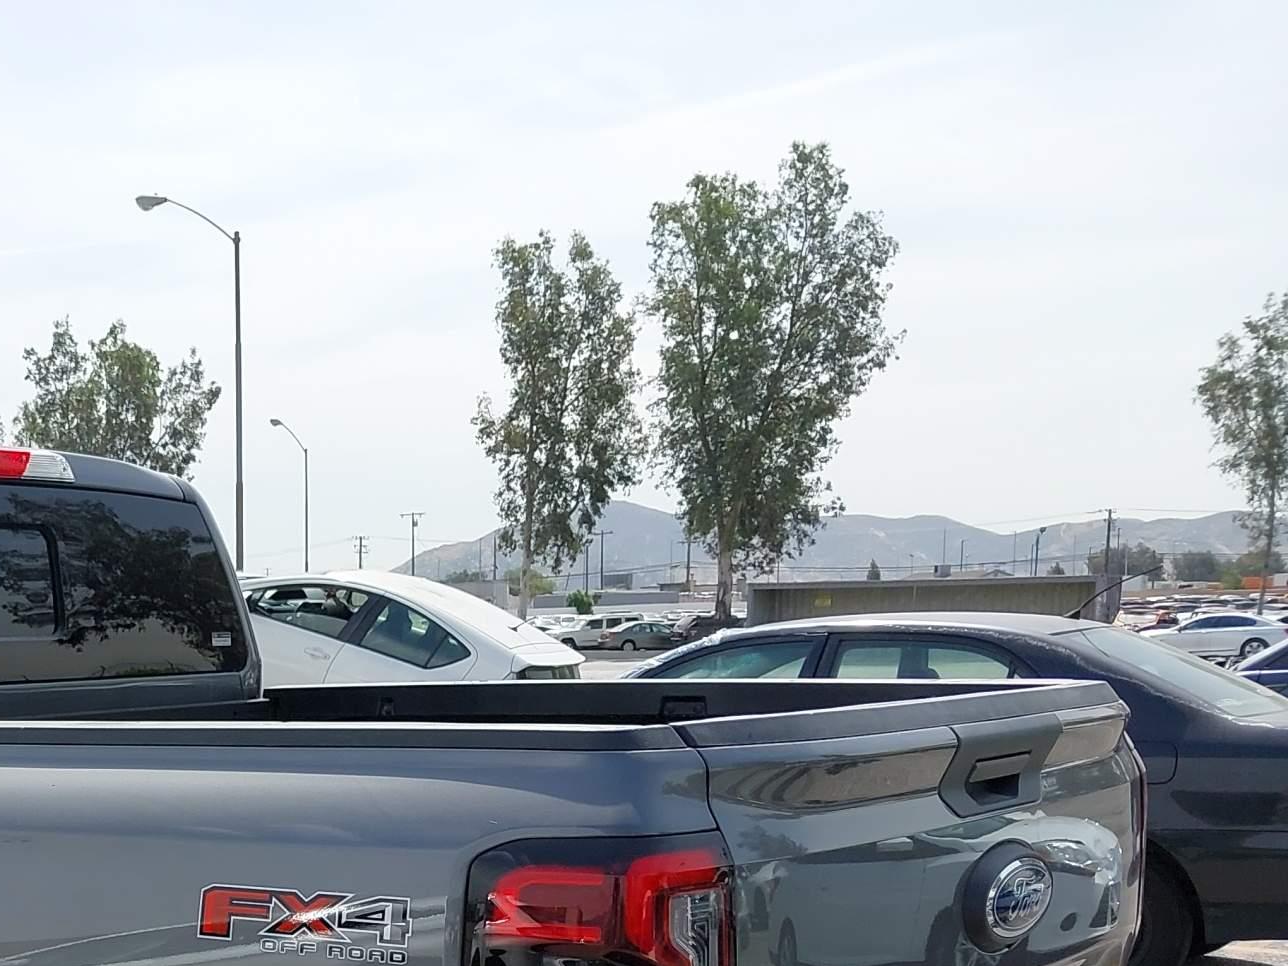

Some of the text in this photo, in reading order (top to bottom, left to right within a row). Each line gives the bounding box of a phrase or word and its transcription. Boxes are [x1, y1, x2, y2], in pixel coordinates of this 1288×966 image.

[197, 883, 413, 948] FX4
[1008, 875, 1045, 921] Ford
[259, 938, 409, 966] OFF ROAD
